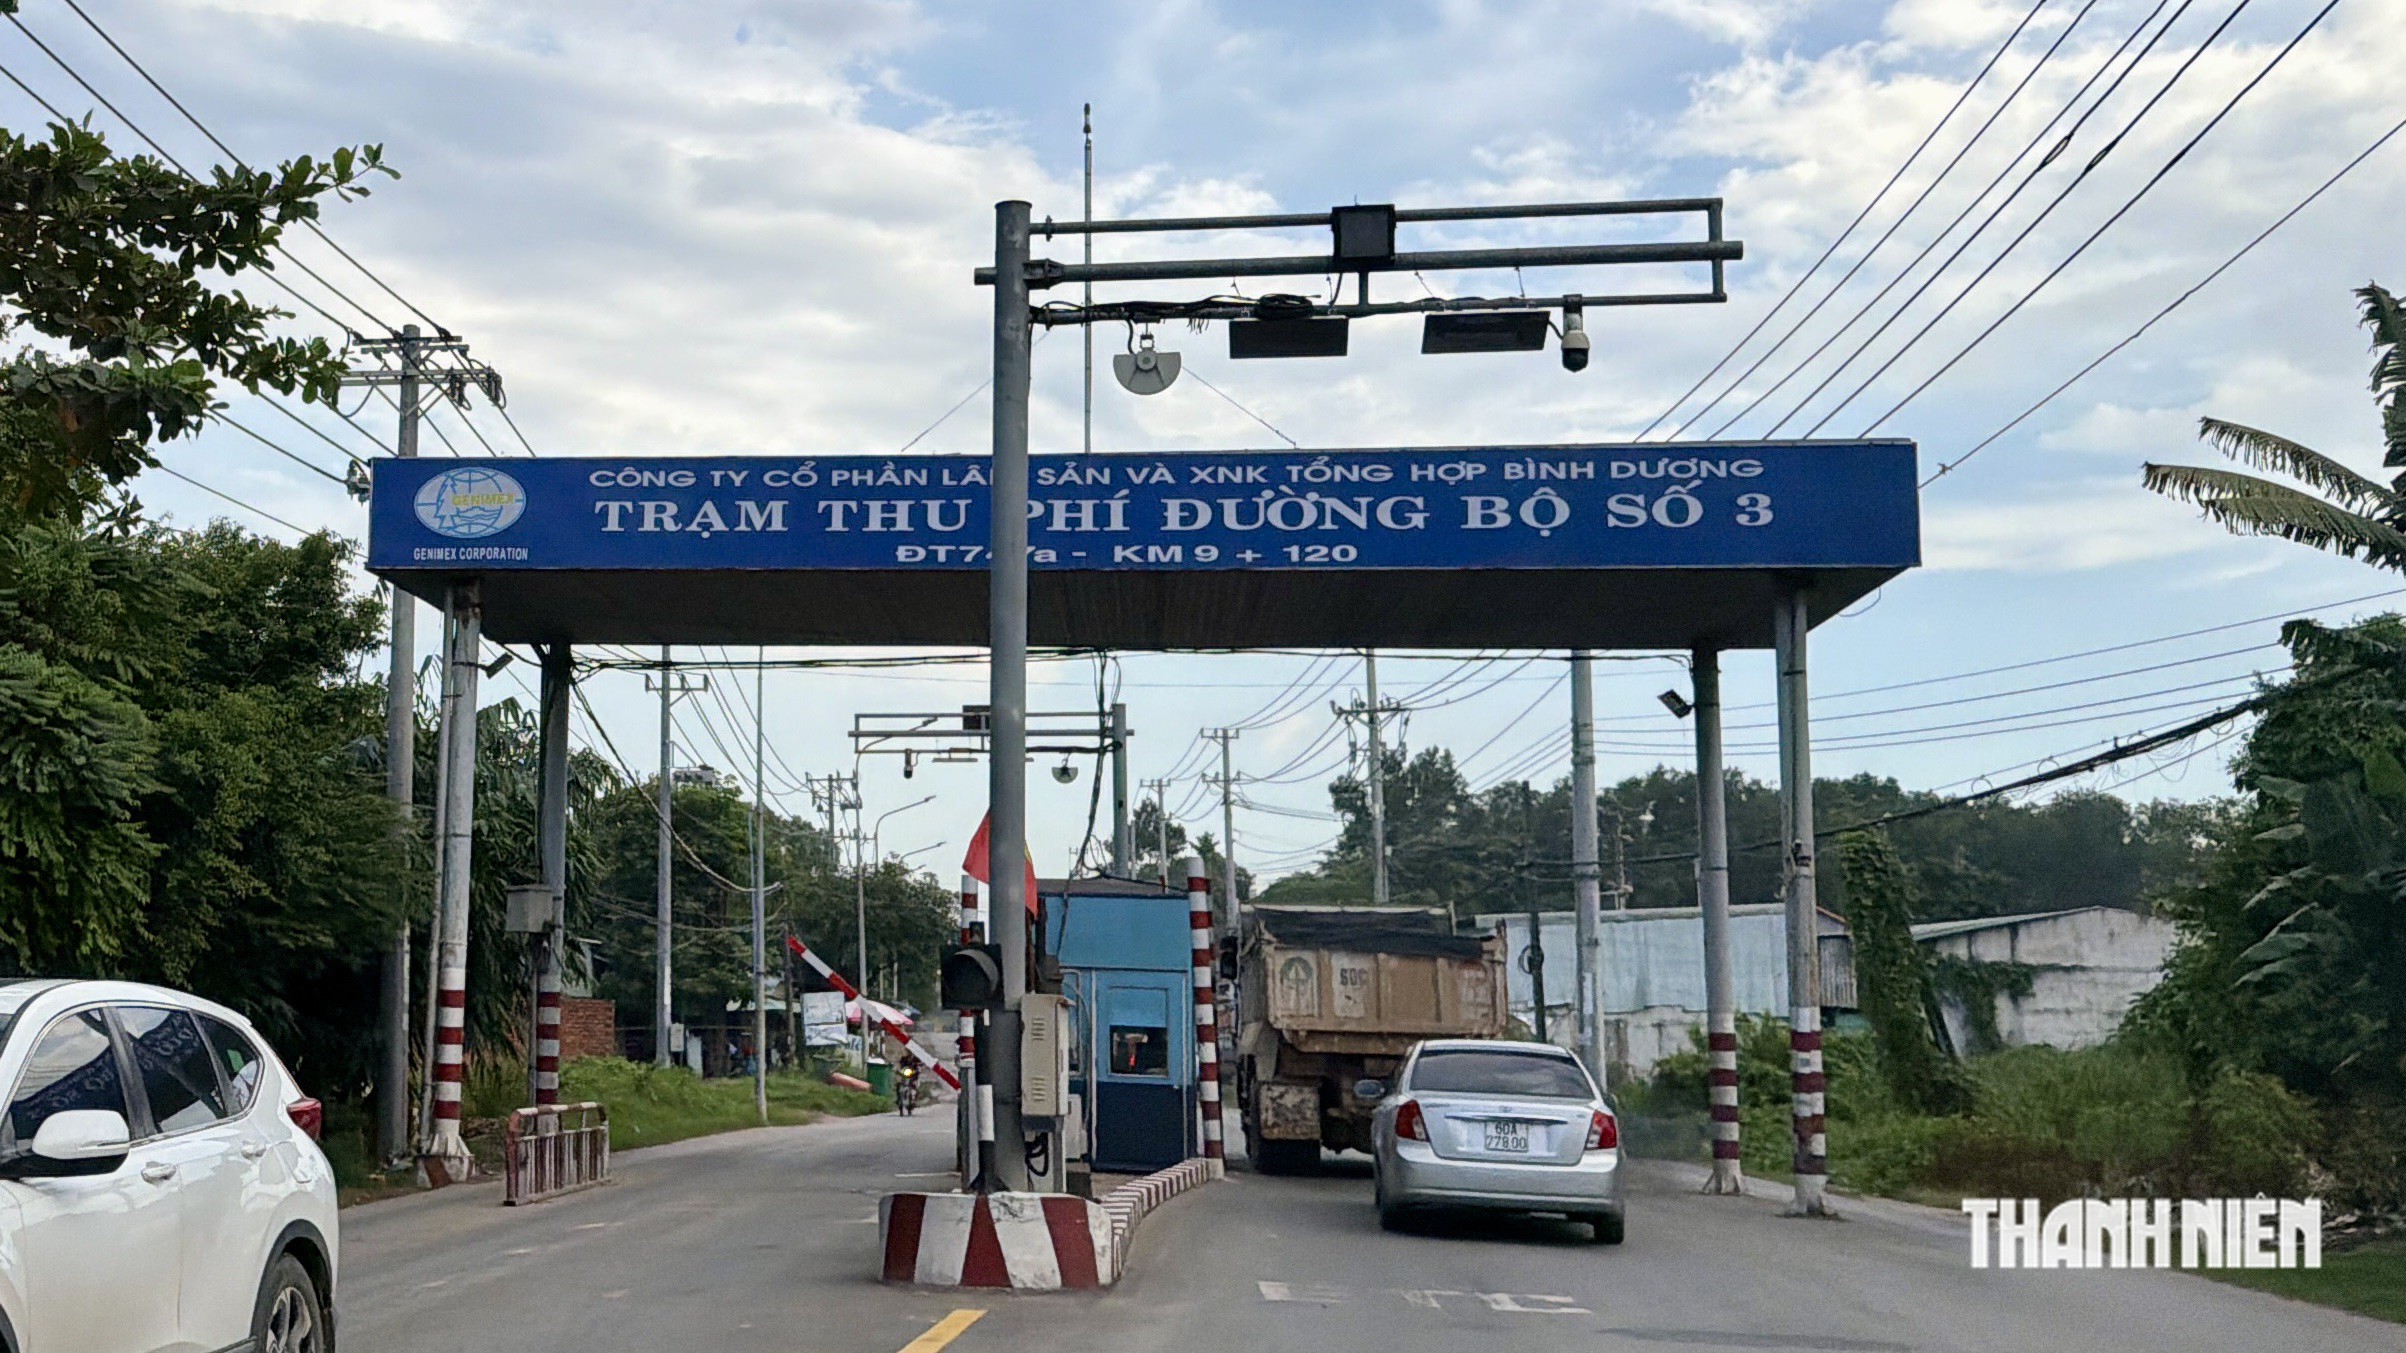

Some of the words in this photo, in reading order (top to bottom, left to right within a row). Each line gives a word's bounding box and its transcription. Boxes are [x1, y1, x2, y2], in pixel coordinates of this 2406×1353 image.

[589, 467, 696, 487] CÔNG
[709, 469, 745, 486] TY
[763, 460, 818, 486] CỔ
[832, 461, 927, 486] PHẦN
[942, 464, 993, 486] LÂ
[1037, 461, 1110, 485] SẢN
[1126, 463, 1174, 484] VÀ
[1191, 465, 1268, 484] XNK
[1286, 456, 1393, 483] TỔNG
[1411, 460, 1486, 485] HỢP
[1504, 458, 1594, 480] BÌNH
[1611, 458, 1764, 478] DƯƠNG
[595, 501, 789, 539] TRẠM
[818, 499, 972, 531] THU
[1160, 485, 1430, 531] ĐƯỜNG
[1460, 487, 1570, 537] BỘ
[1608, 480, 1704, 528] SỐ
[1736, 494, 1773, 526] 3
[414, 548, 456, 560] GENIMEX
[459, 547, 528, 560] CORPORATION
[895, 546, 1057, 563] ĐT7a
[1113, 545, 1182, 563] KM
[1195, 545, 1219, 562] 9
[1236, 549, 1262, 562] +
[1282, 545, 1358, 562] 120
